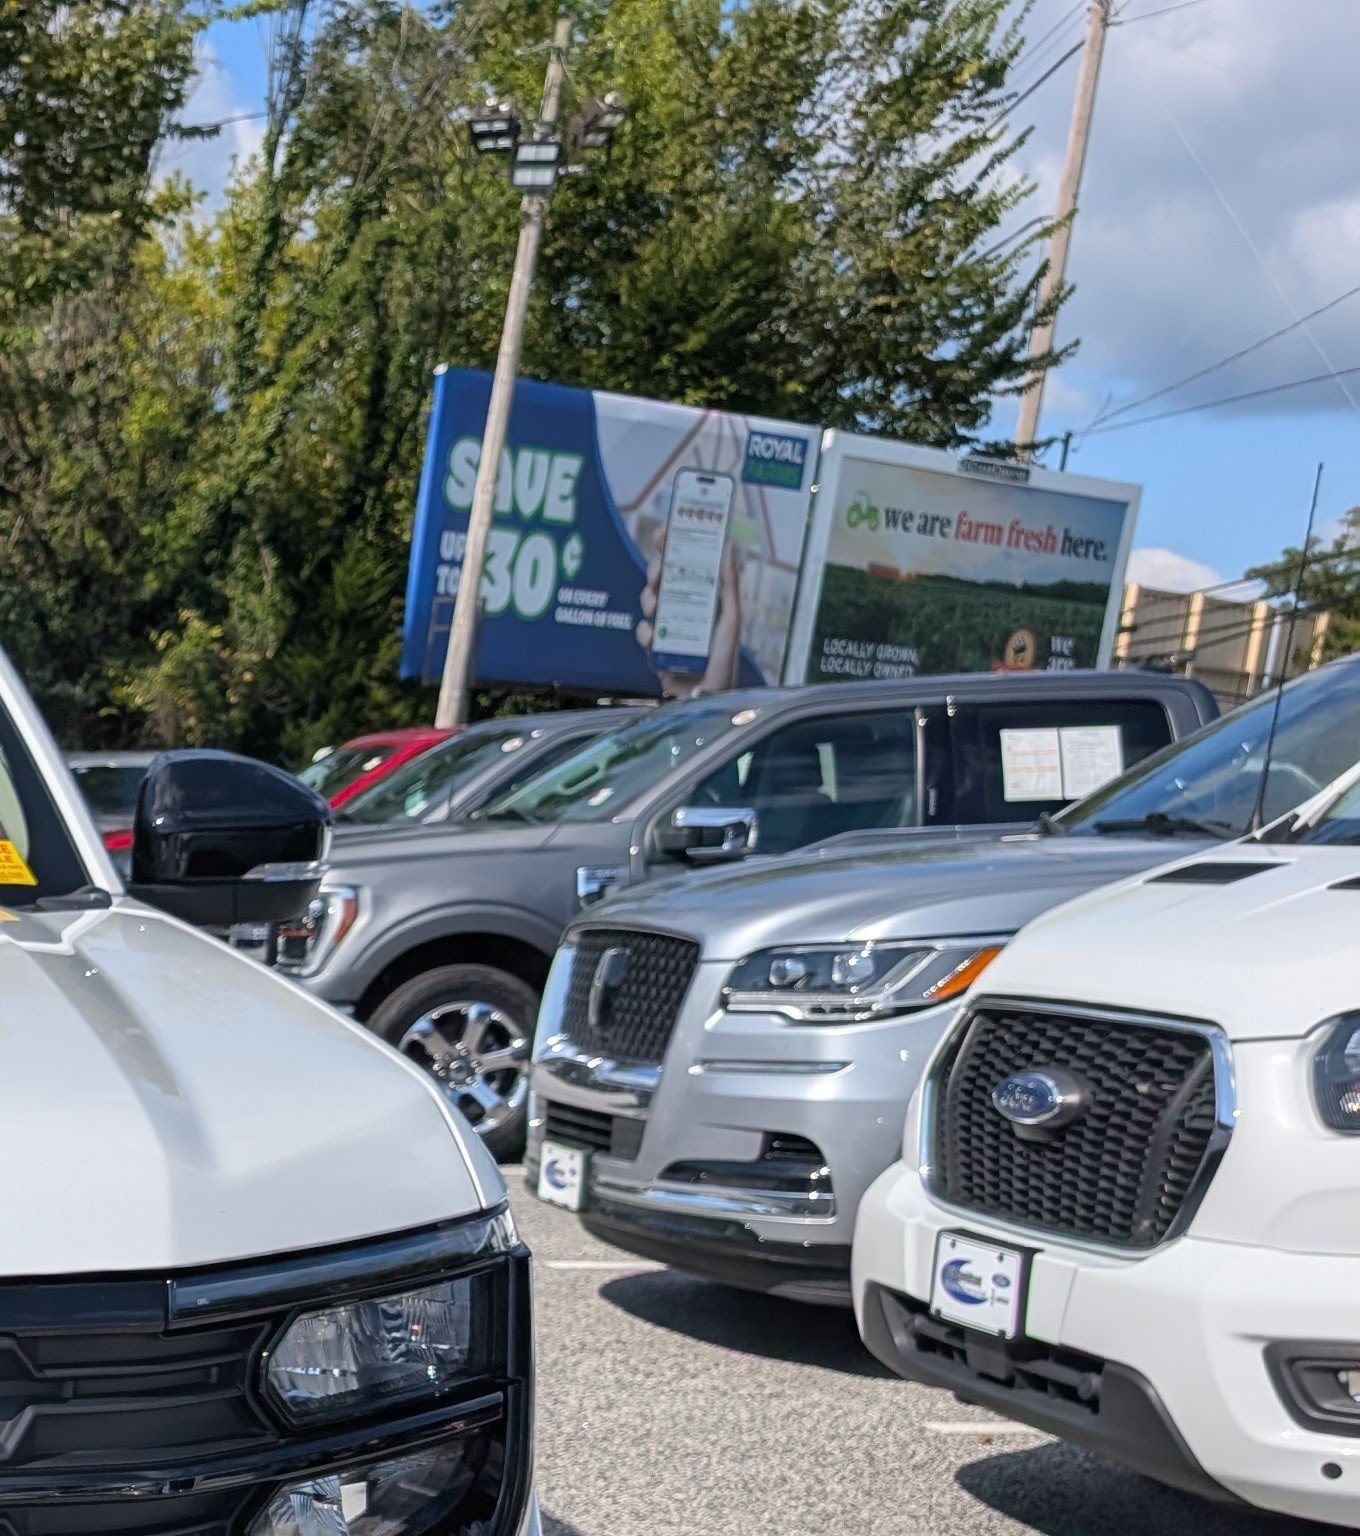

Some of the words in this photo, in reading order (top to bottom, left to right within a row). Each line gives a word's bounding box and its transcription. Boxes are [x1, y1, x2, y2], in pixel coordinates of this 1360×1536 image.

[749, 434, 803, 464] ROYAL
[884, 506, 914, 533] we
[917, 512, 952, 540] are
[954, 510, 1003, 547] farm
[1005, 518, 1058, 555] fresh
[1060, 527, 1107, 562] here.
[823, 638, 875, 659] LOCALLY
[1051, 635, 1074, 656] we
[820, 655, 872, 676] LOCALLY
